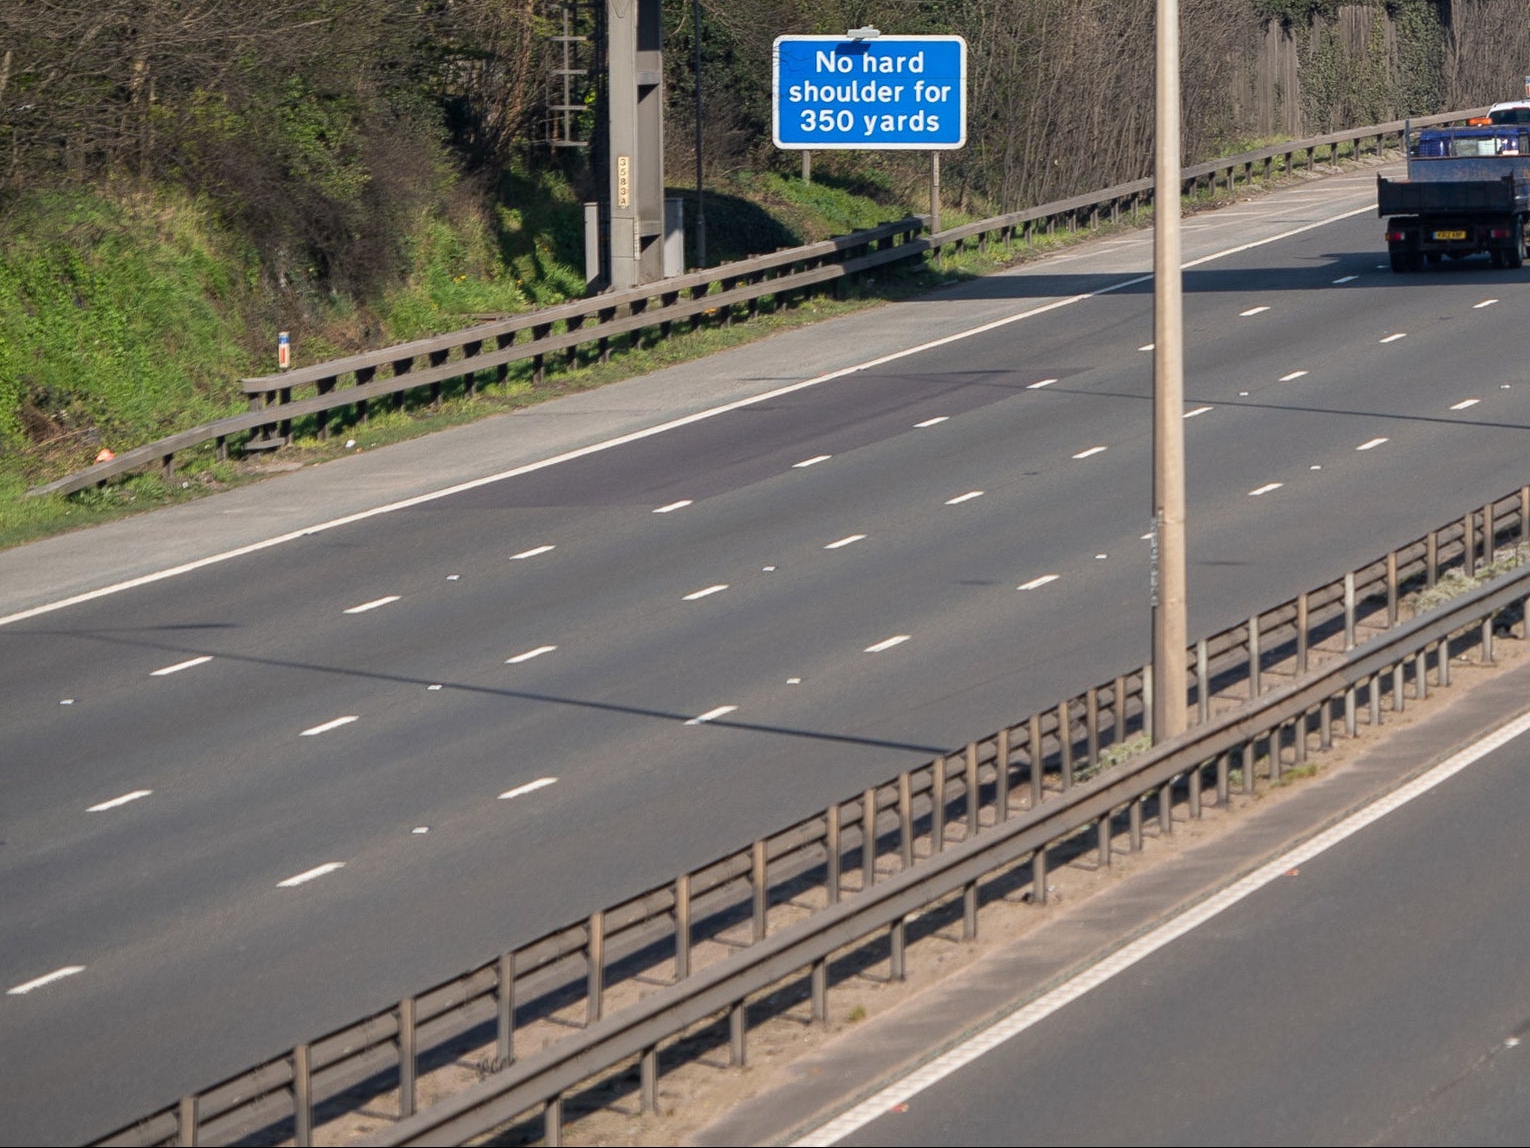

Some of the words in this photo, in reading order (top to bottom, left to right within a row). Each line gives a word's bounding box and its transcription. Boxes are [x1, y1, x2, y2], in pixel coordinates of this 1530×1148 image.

[816, 51, 853, 73] No
[863, 51, 924, 73] hard
[789, 80, 904, 103] shoulder
[914, 80, 951, 103] for
[800, 109, 854, 132] 350
[864, 109, 940, 136] yards
